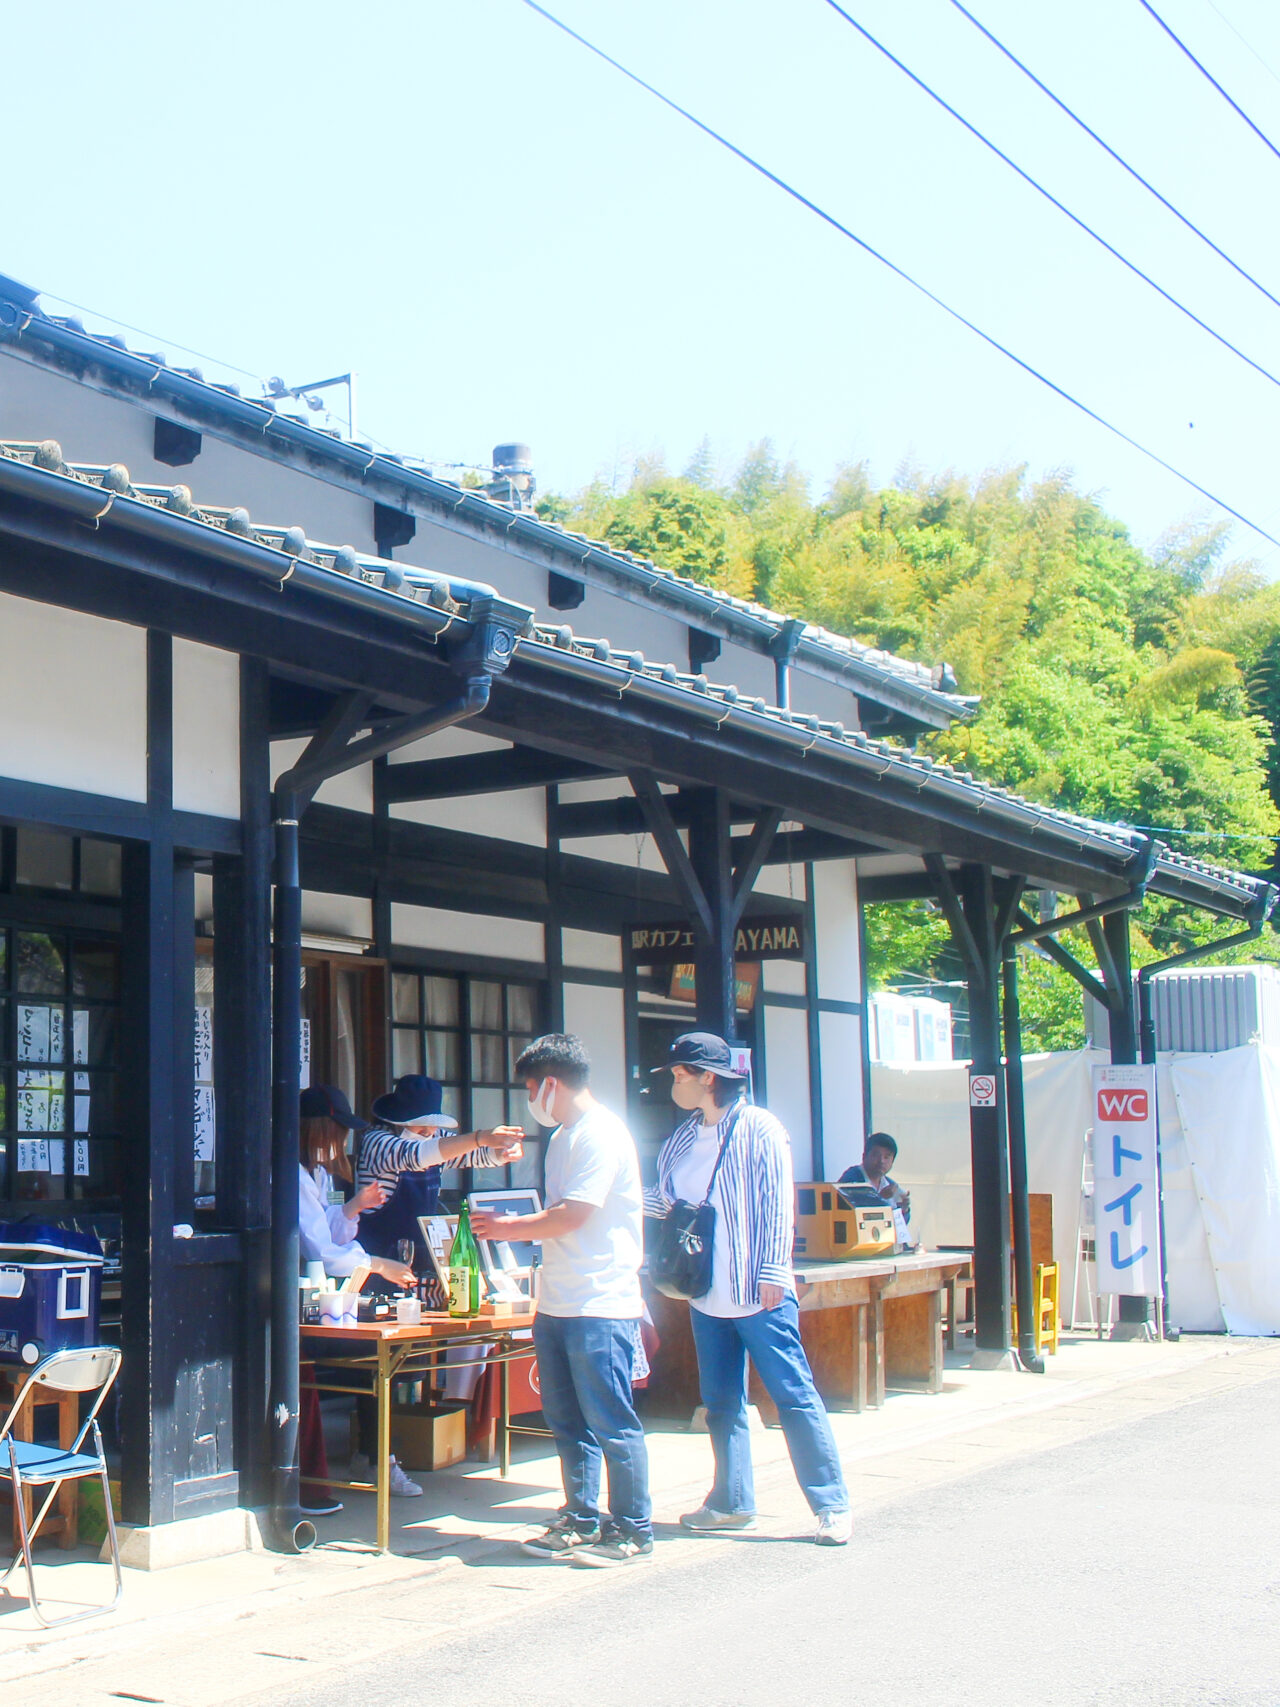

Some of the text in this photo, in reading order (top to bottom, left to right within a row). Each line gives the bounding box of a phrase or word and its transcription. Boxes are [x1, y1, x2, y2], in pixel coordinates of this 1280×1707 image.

[631, 929, 696, 949] 駅カフェ
[202, 1009, 211, 1061] くじら入り
[1100, 1094, 1147, 1118] WC
[1103, 1133, 1148, 1270] トイレ
